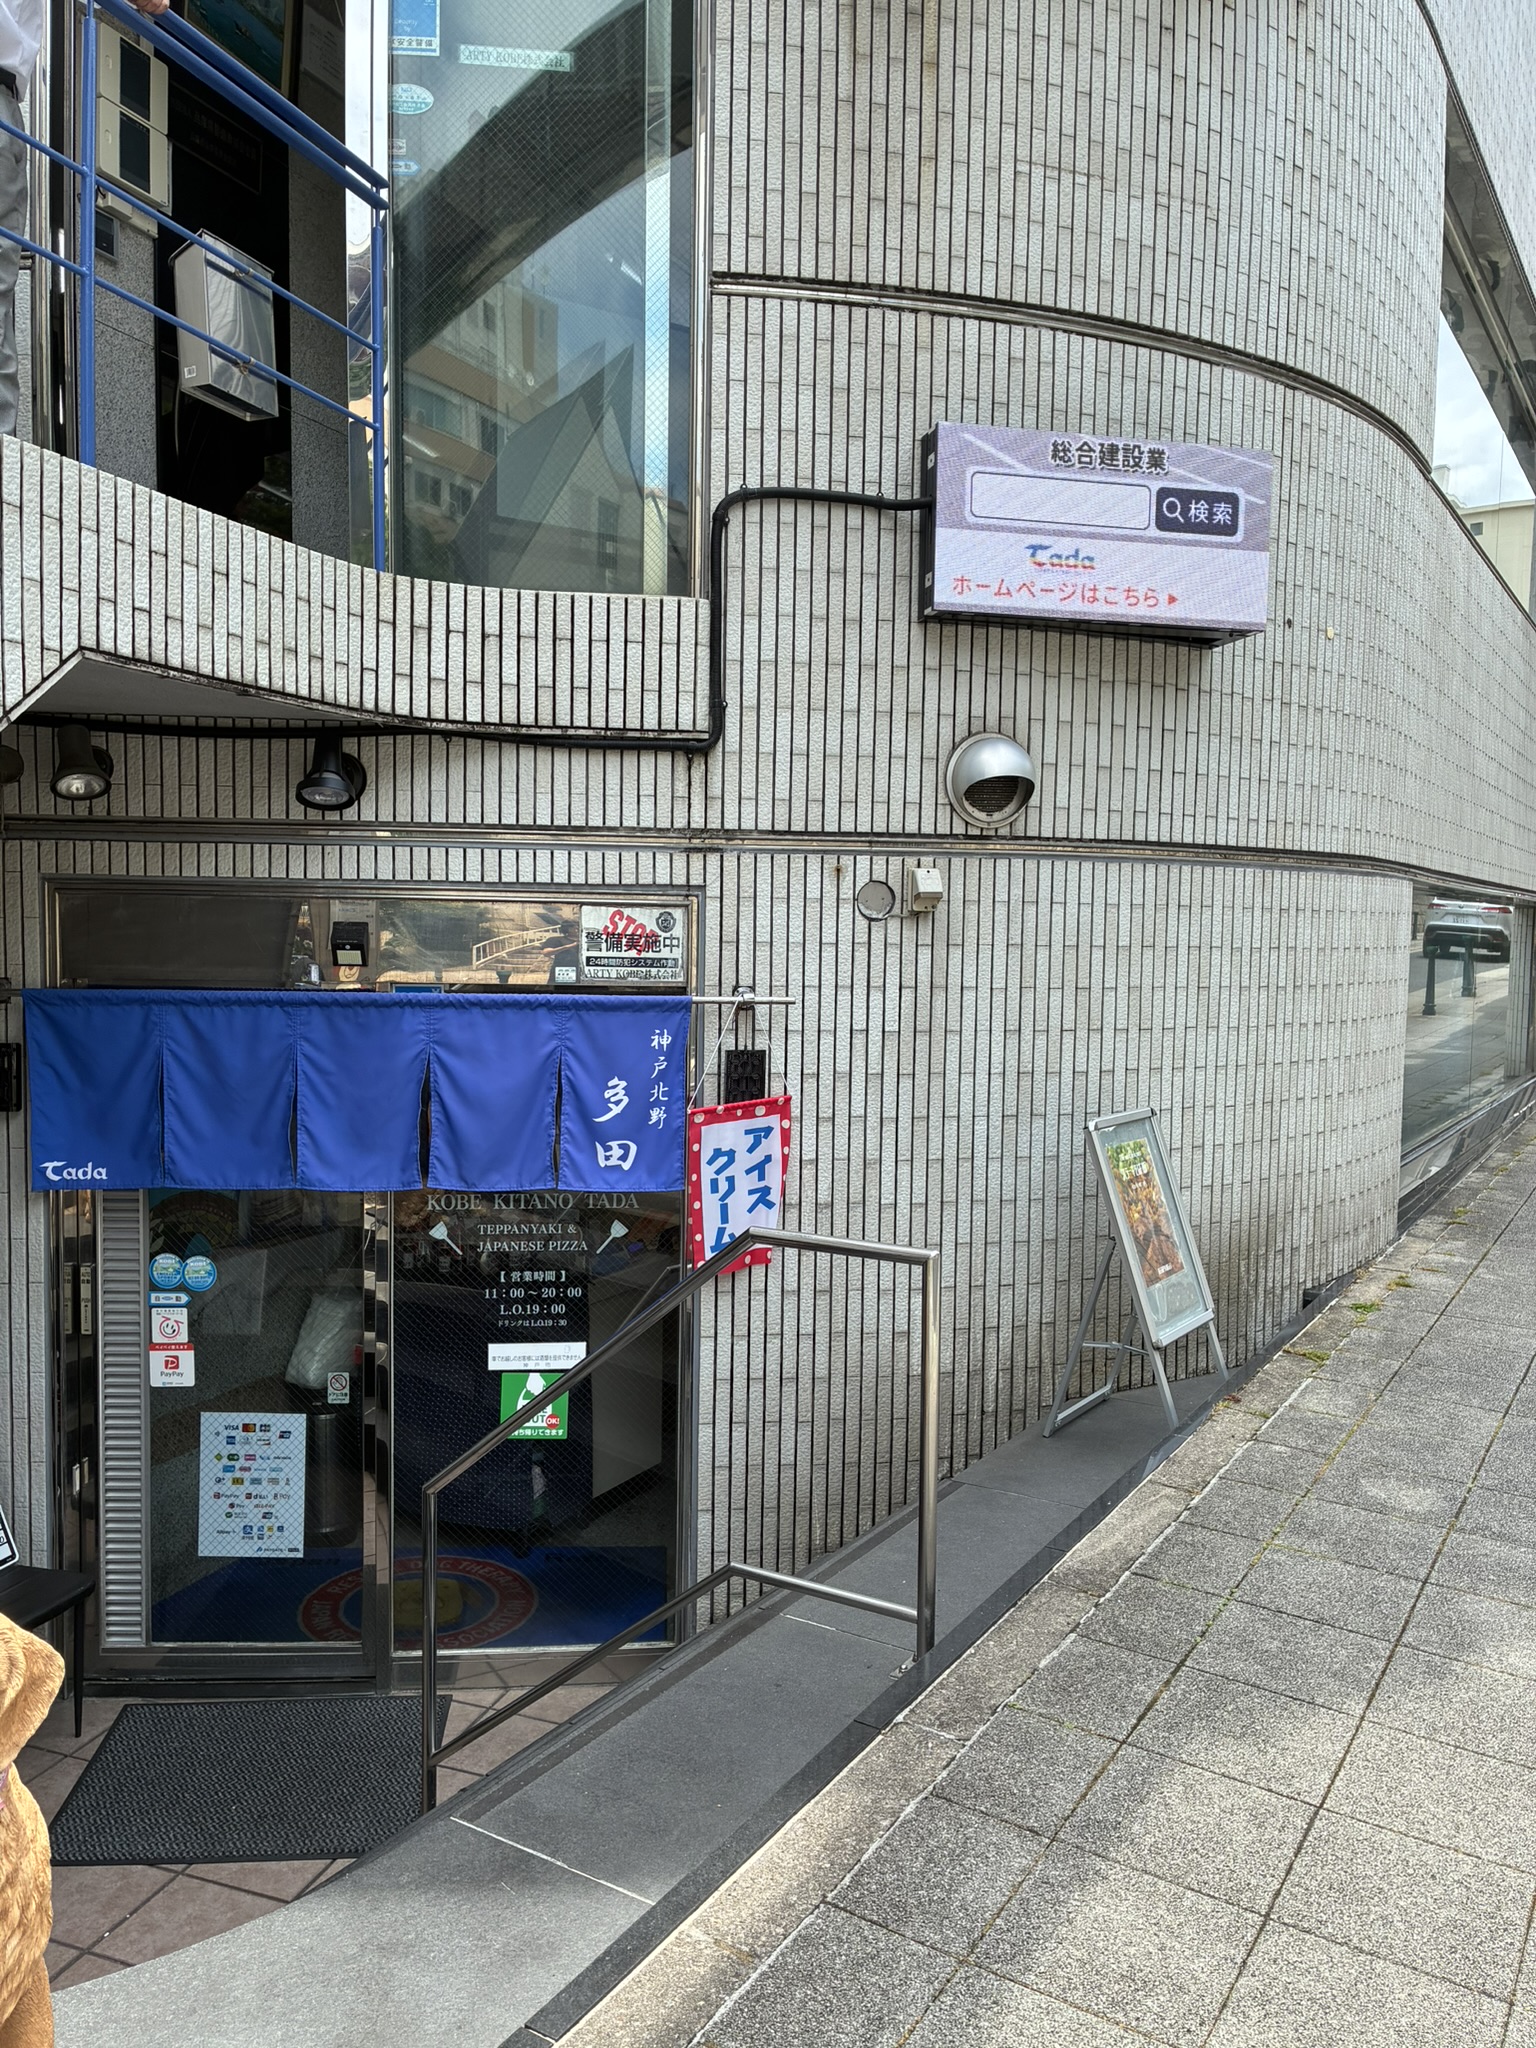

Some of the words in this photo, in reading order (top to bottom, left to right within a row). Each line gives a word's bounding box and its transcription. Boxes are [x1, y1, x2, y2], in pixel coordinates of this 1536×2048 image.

[1050, 438, 1169, 474] 総合建設業
[1188, 499, 1233, 525] 検索
[1025, 544, 1095, 570] Tada
[953, 575, 1160, 608] ホームページはこちら
[585, 931, 681, 954] 警備実施中
[648, 1029, 672, 1130] 神戸北野
[593, 1076, 637, 1171] 多田
[39, 1161, 108, 1181] Tada
[744, 1126, 777, 1214] アイス
[426, 1194, 482, 1211] KOBE
[494, 1193, 573, 1211] KITANO
[584, 1193, 640, 1209] TADA
[706, 1148, 737, 1253] クリーム
[477, 1224, 562, 1235] TEPPANYAKI
[567, 1224, 577, 1234] &
[477, 1241, 545, 1253] JAPANESE
[549, 1240, 588, 1251] PIZZA
[547, 1417, 560, 1425] OK!
[410, 1559, 452, 1570] DG
[437, 1600, 527, 1648] SSOCIATION
